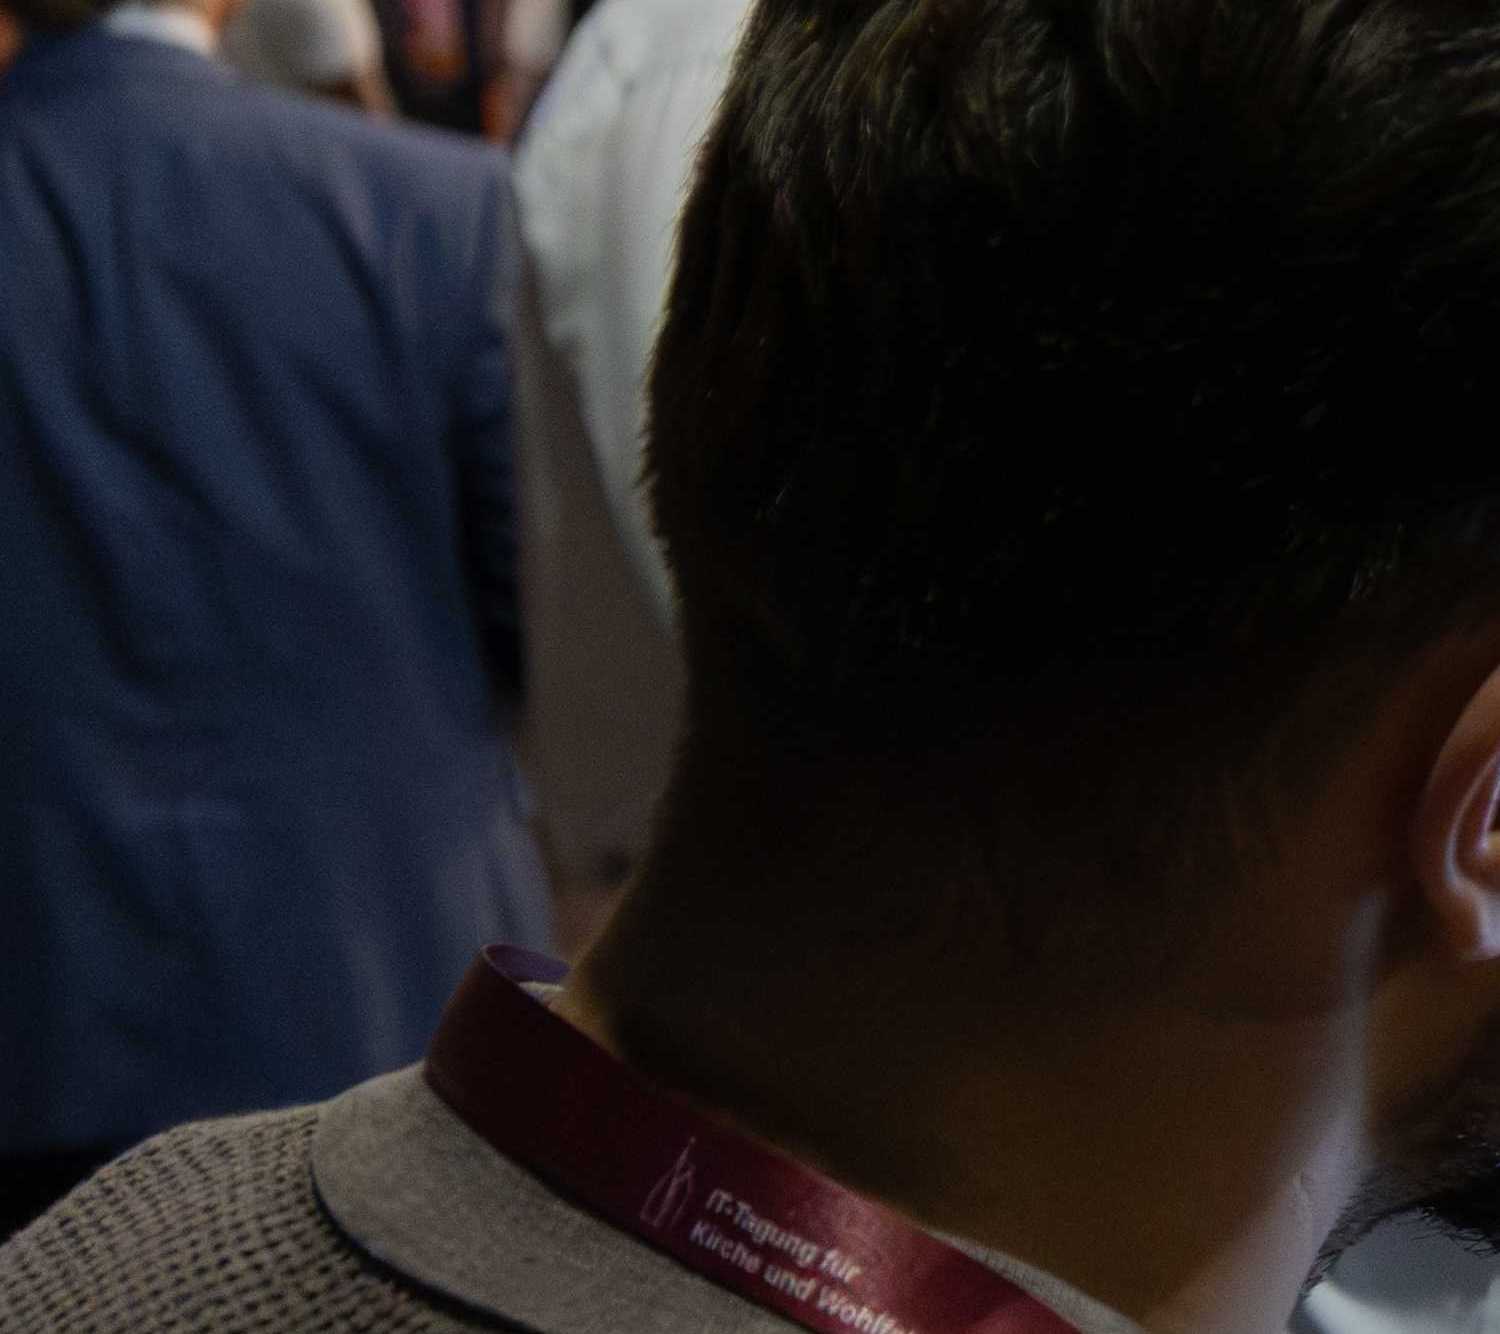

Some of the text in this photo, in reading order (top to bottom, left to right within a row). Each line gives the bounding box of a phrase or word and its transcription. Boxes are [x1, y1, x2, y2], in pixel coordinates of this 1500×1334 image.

[689, 1219, 763, 1274] Kirche
[763, 1263, 816, 1303] und
[704, 1187, 862, 1284] IT-Tagung für
